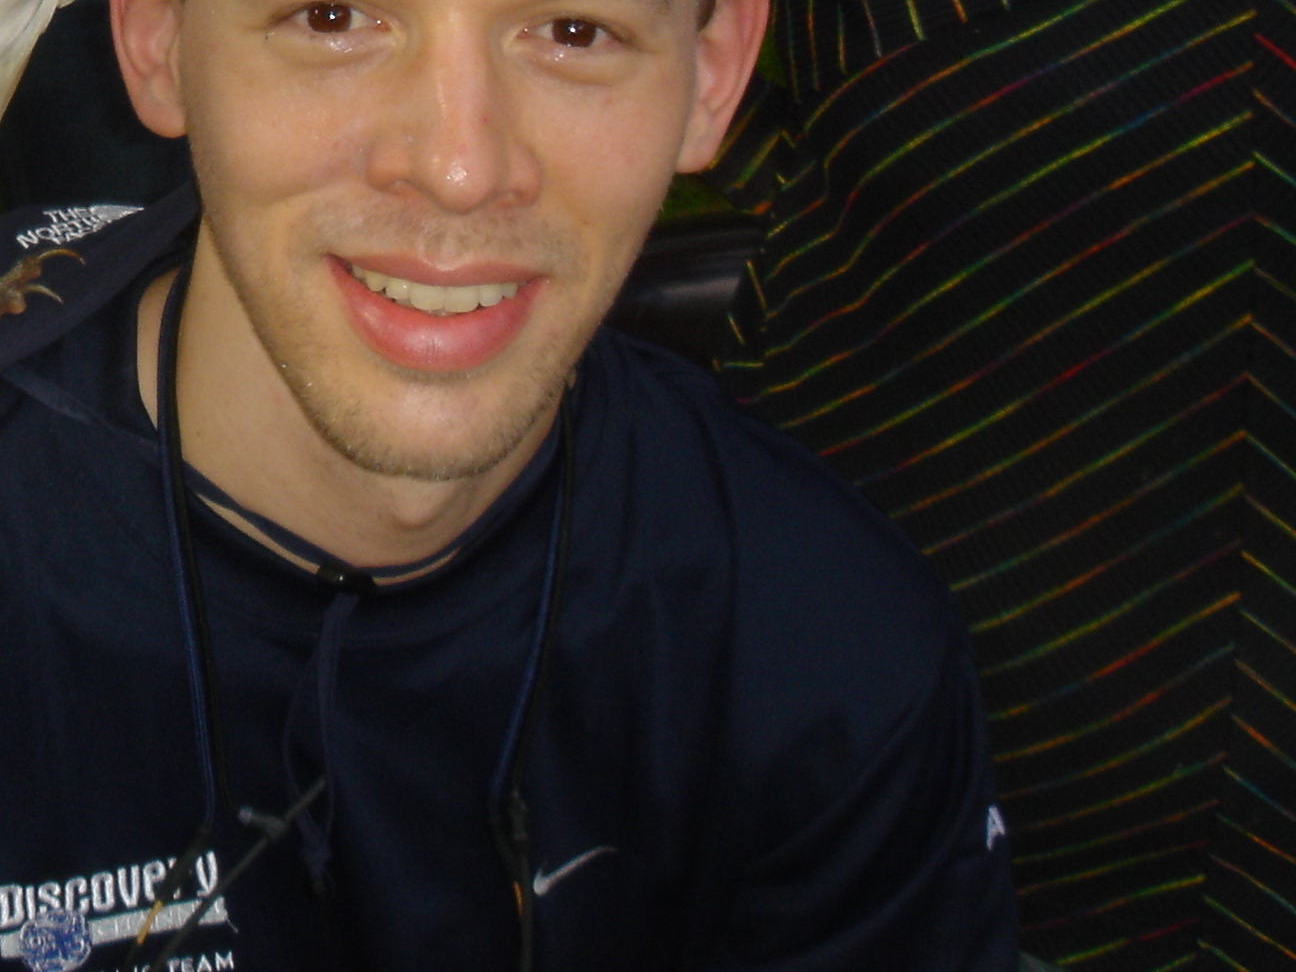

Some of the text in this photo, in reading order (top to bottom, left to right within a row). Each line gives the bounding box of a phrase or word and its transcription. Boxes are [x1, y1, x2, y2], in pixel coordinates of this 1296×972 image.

[42, 206, 91, 223] THE
[16, 215, 101, 249] NORTH
[167, 950, 235, 972] TEAM
